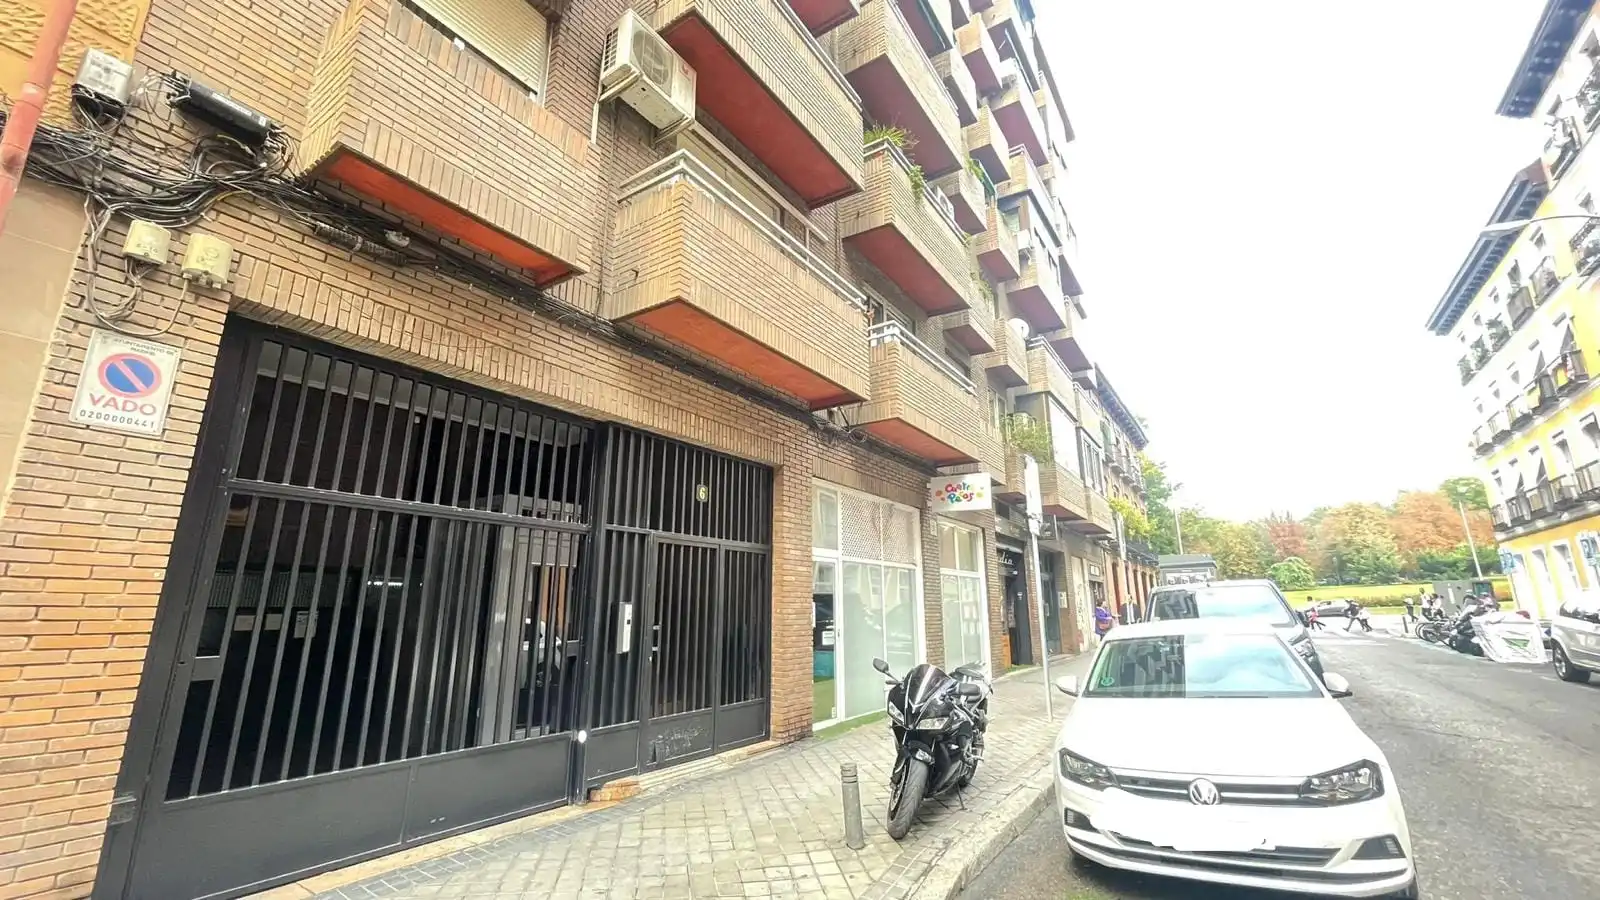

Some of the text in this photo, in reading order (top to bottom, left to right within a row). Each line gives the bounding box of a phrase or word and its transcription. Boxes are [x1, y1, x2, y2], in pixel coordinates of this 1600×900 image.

[89, 392, 157, 416] VADO
[79, 409, 155, 429] 0200000441
[699, 486, 706, 500] 6
